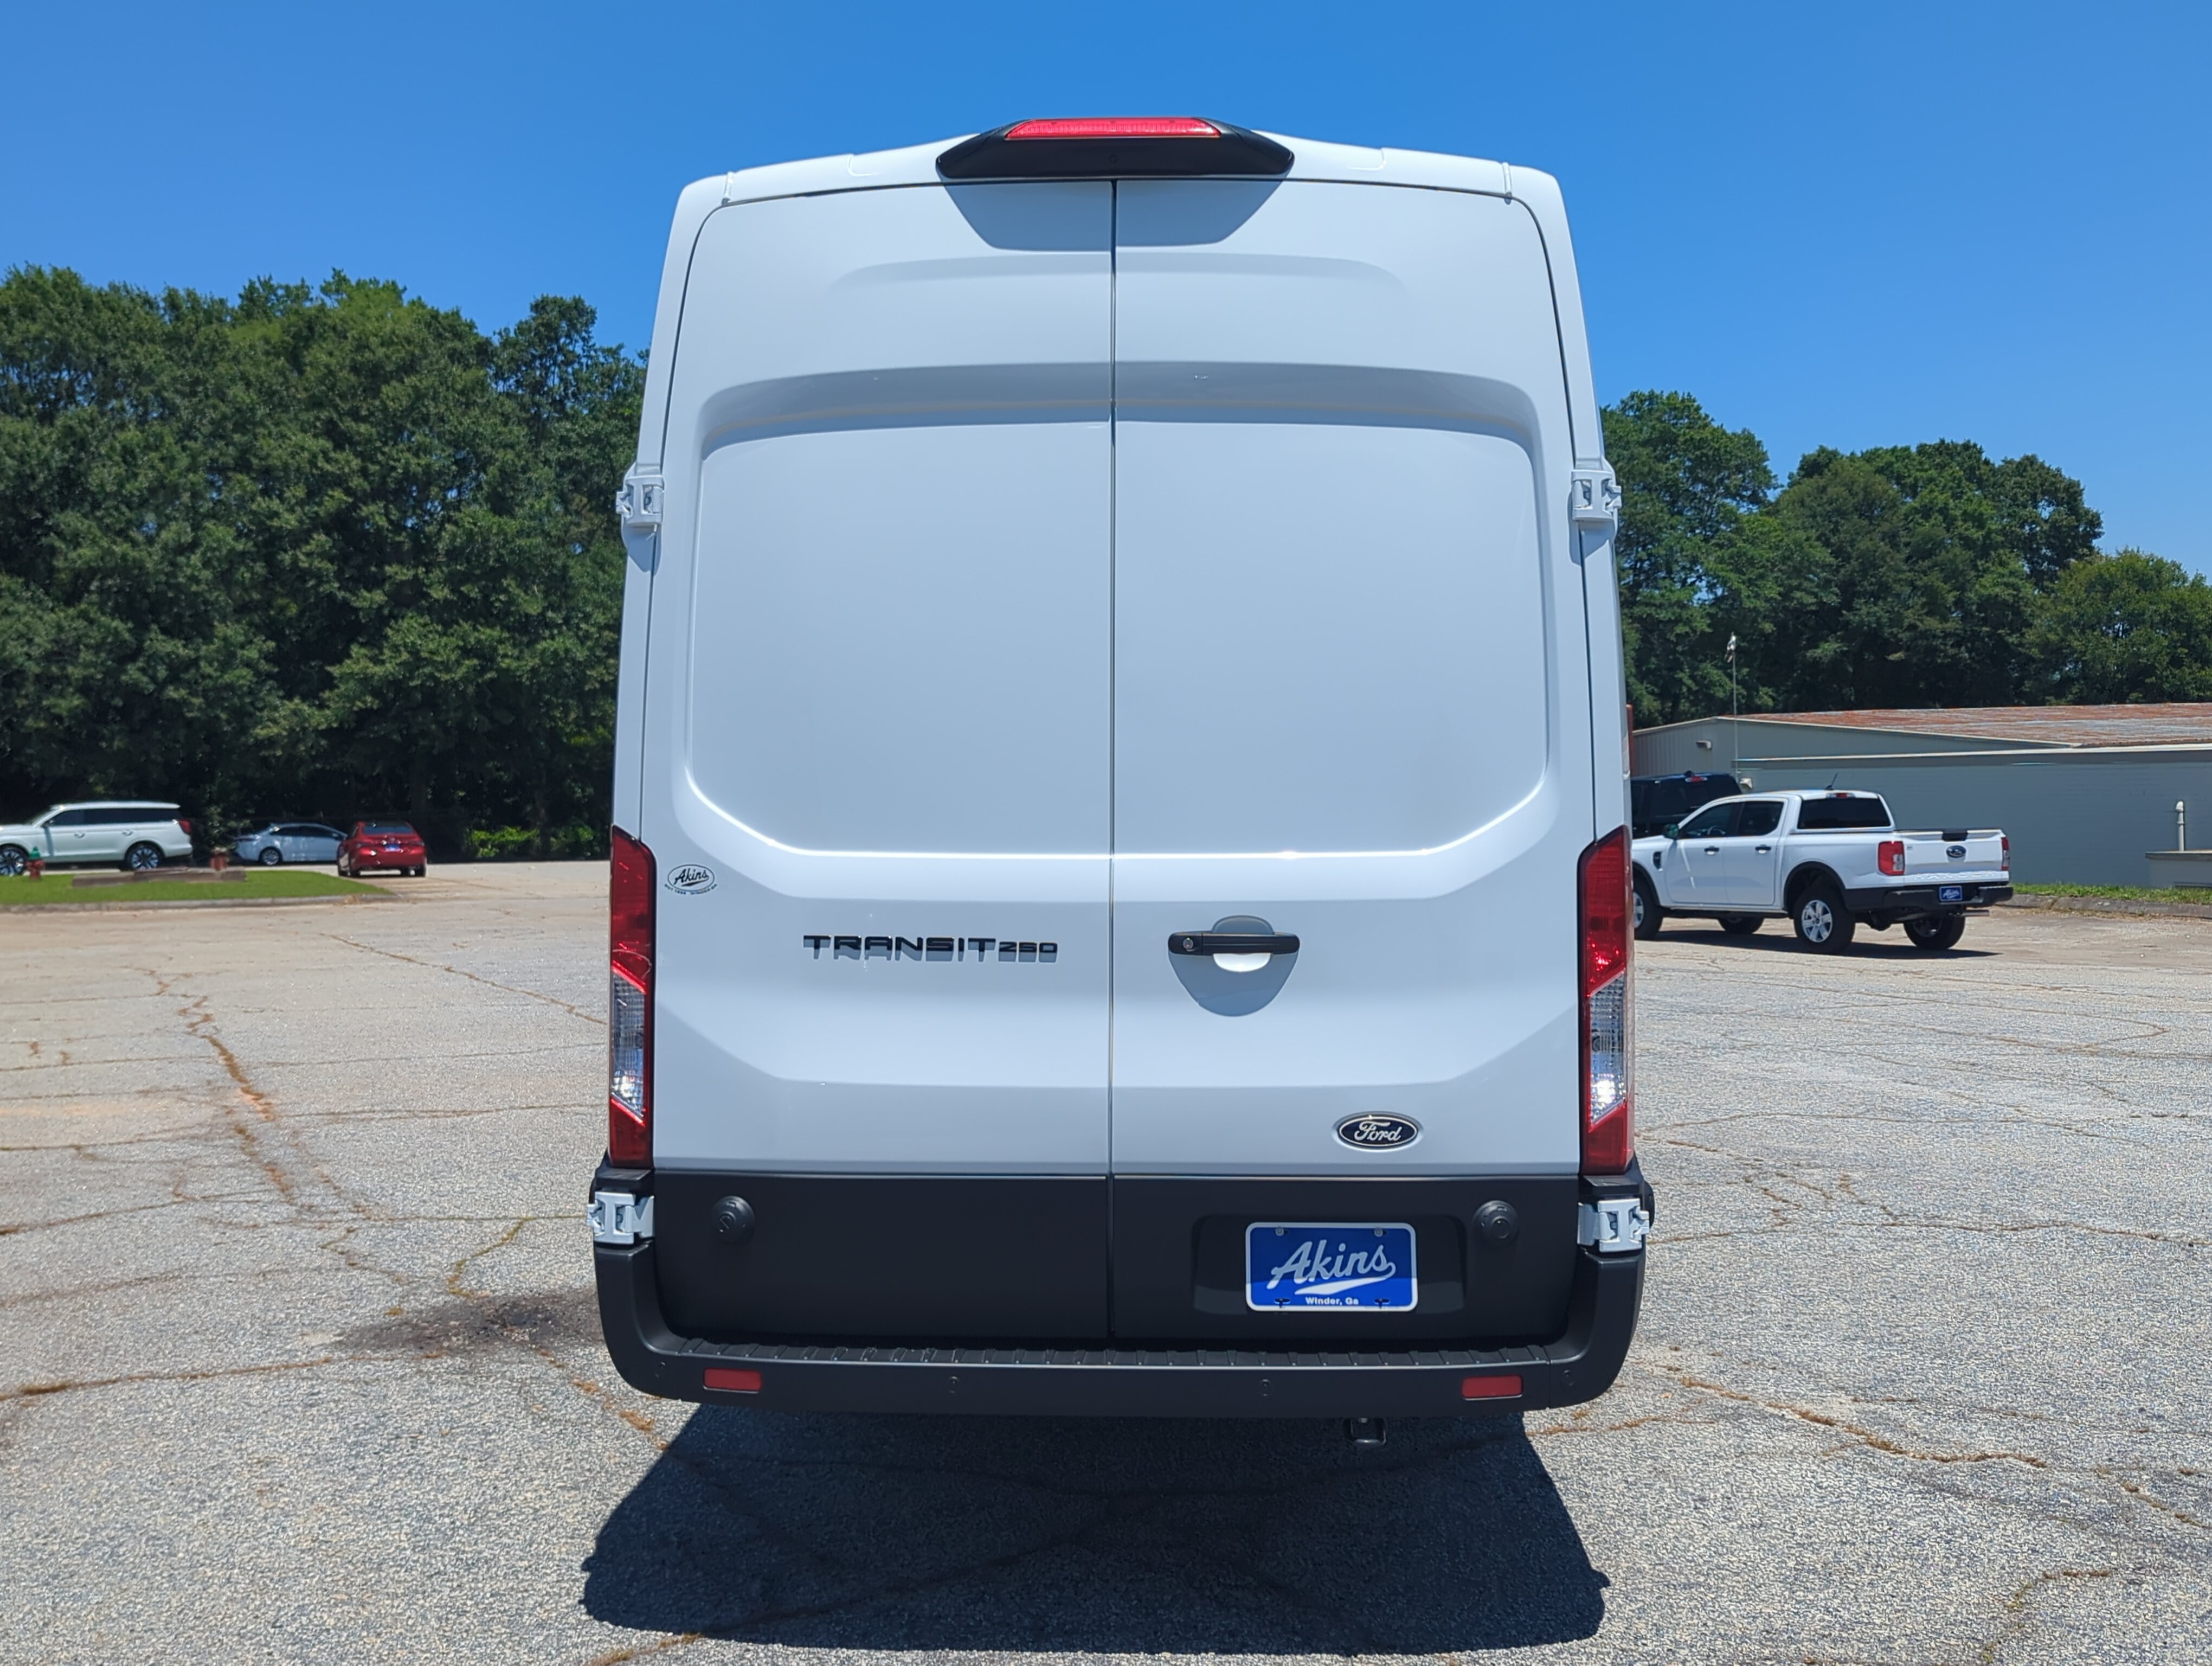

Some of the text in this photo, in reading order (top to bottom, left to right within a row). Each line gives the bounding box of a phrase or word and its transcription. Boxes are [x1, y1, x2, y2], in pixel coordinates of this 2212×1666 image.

[673, 868, 709, 885] Akins
[1354, 1120, 1403, 1141] Ford
[1266, 1239, 1396, 1290] Akins
[1306, 1297, 1359, 1305] Winder, Ga
